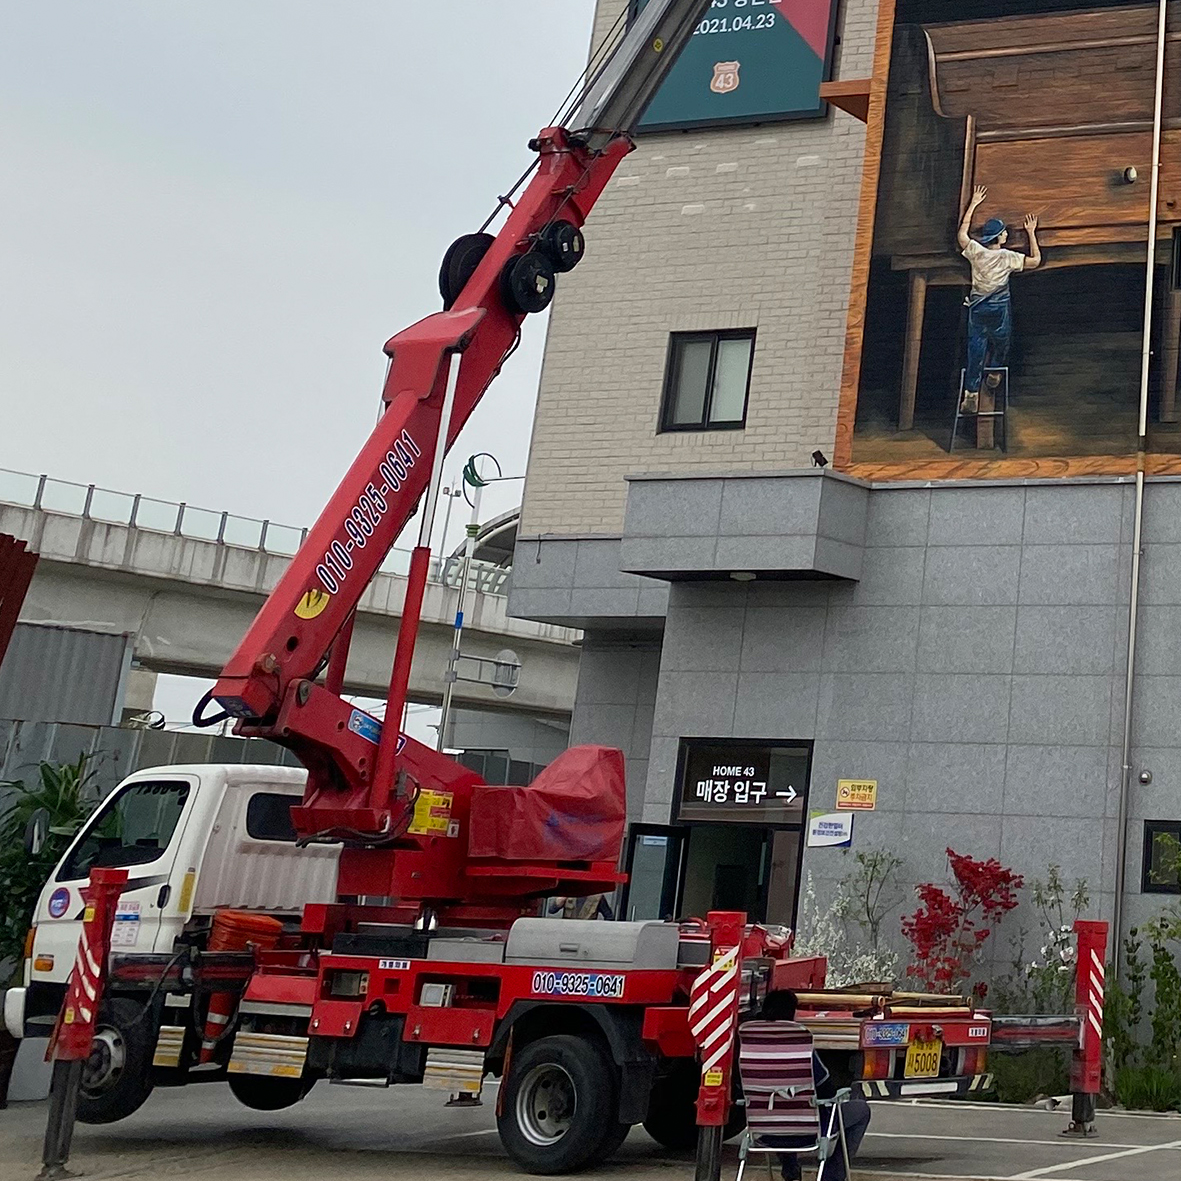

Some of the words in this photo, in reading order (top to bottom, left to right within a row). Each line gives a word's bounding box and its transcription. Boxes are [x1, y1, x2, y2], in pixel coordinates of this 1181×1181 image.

[715, 74, 734, 88] 43
[316, 429, 421, 595] 010-9325-0641
[712, 766, 742, 777] HOME
[743, 767, 755, 777] 43
[696, 779, 731, 803] 매장
[733, 781, 767, 804] 입구
[532, 972, 624, 996] 010-9325-0641
[914, 1052, 938, 1072] 5008
